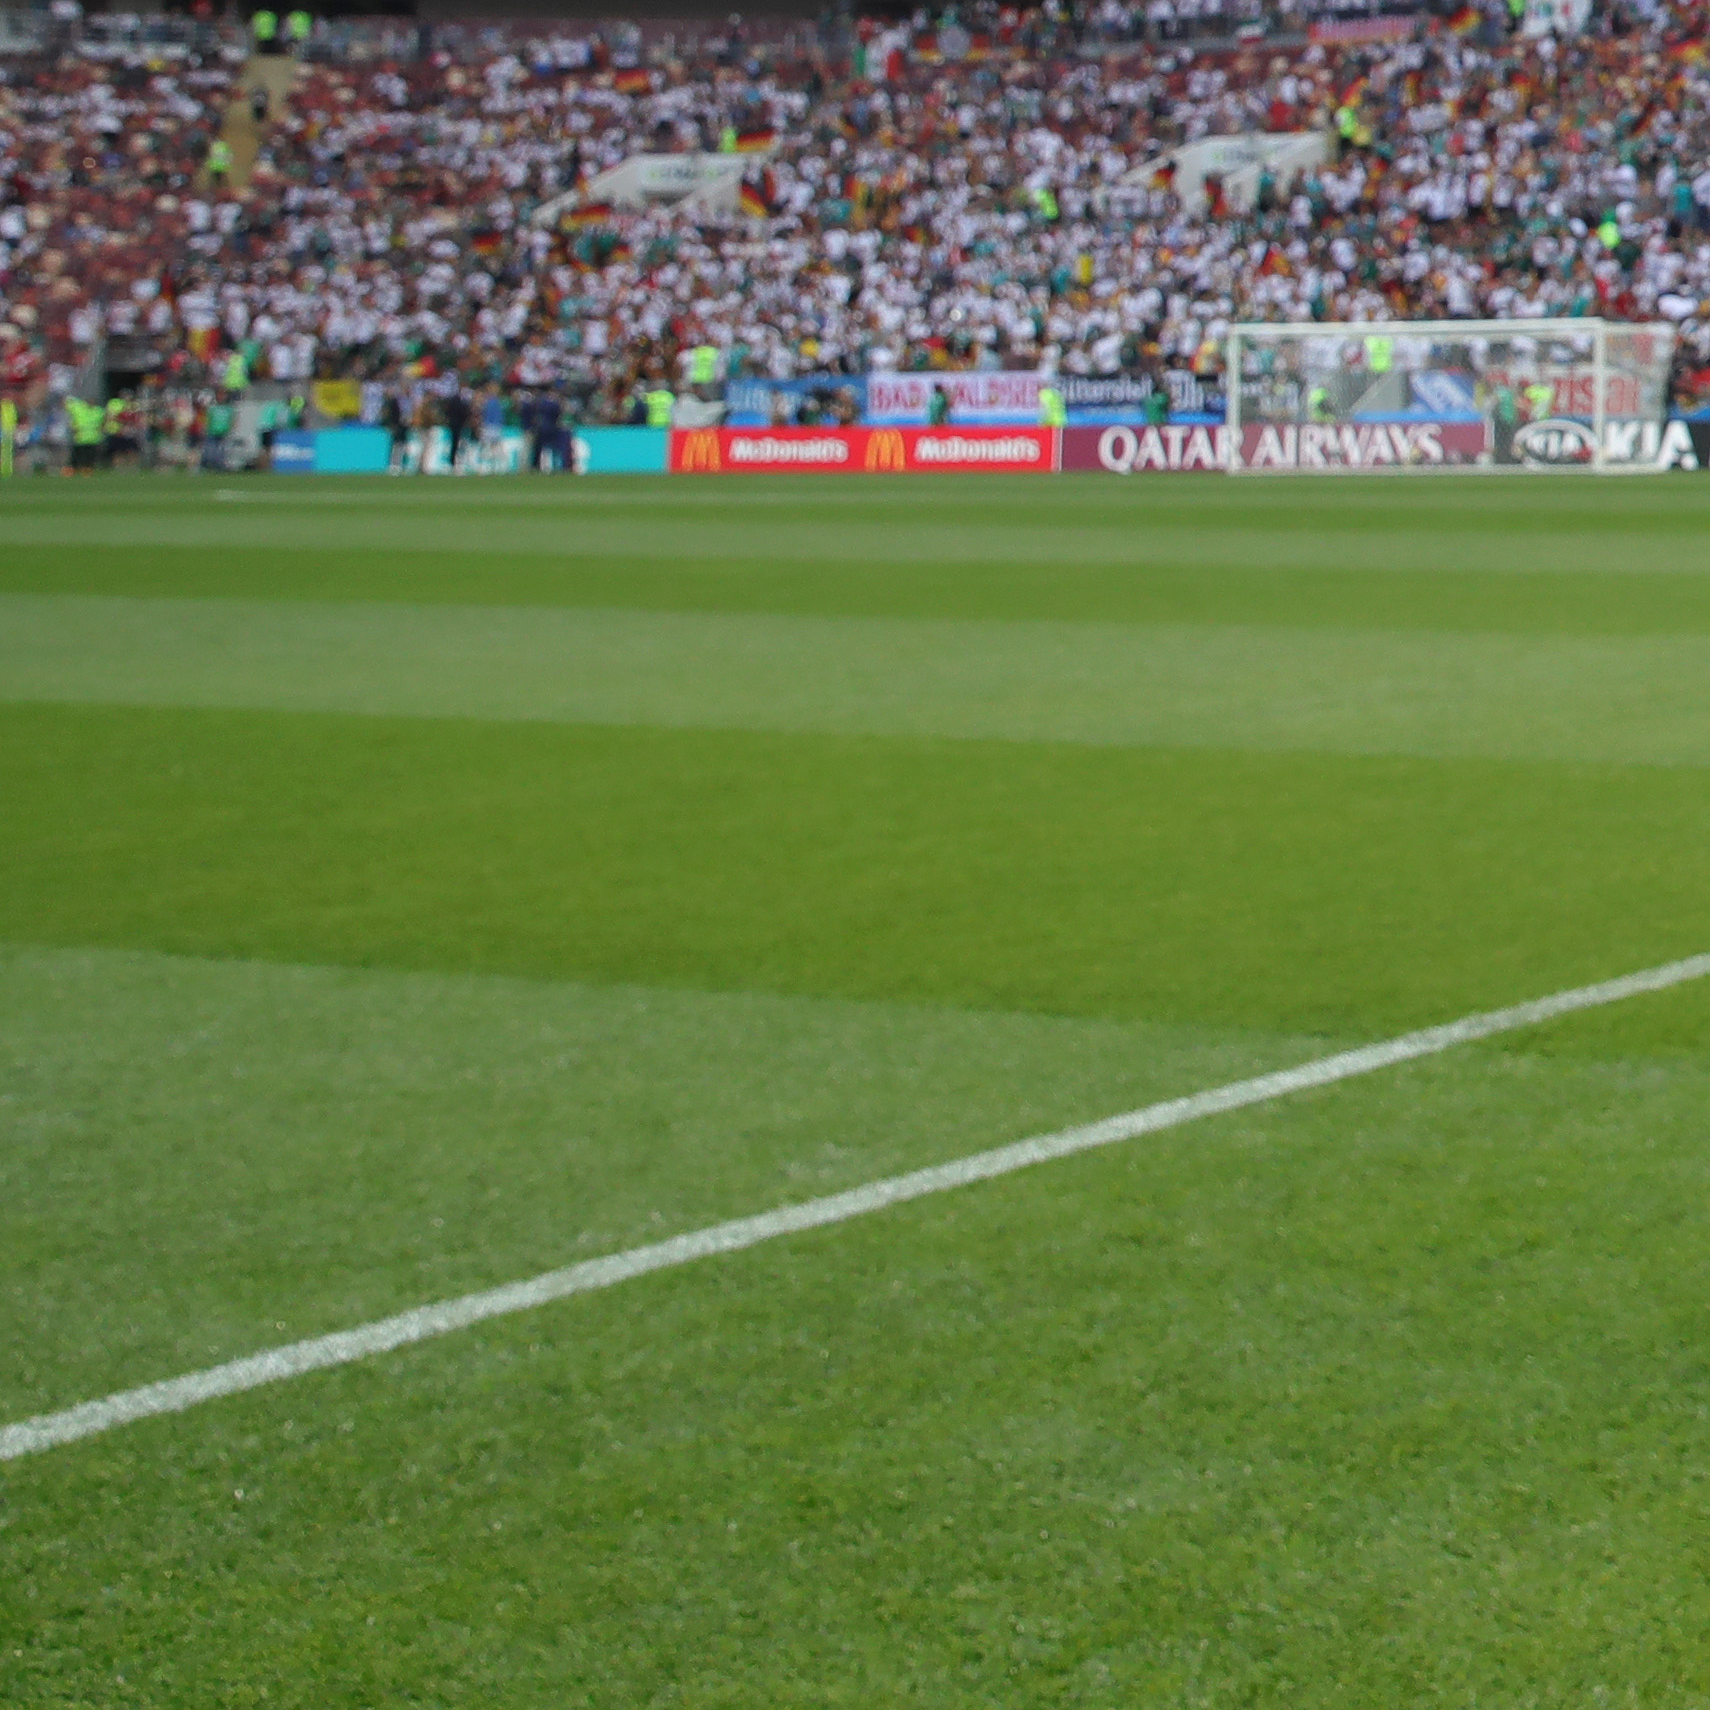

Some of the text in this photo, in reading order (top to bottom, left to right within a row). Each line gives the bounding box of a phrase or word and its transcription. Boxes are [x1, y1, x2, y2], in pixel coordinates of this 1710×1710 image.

[729, 437, 849, 463] McDonald's
[915, 435, 1041, 463] McDonald's
[1098, 421, 1445, 474] QATAR AIRWAYS
[1603, 418, 1697, 471] KIA
